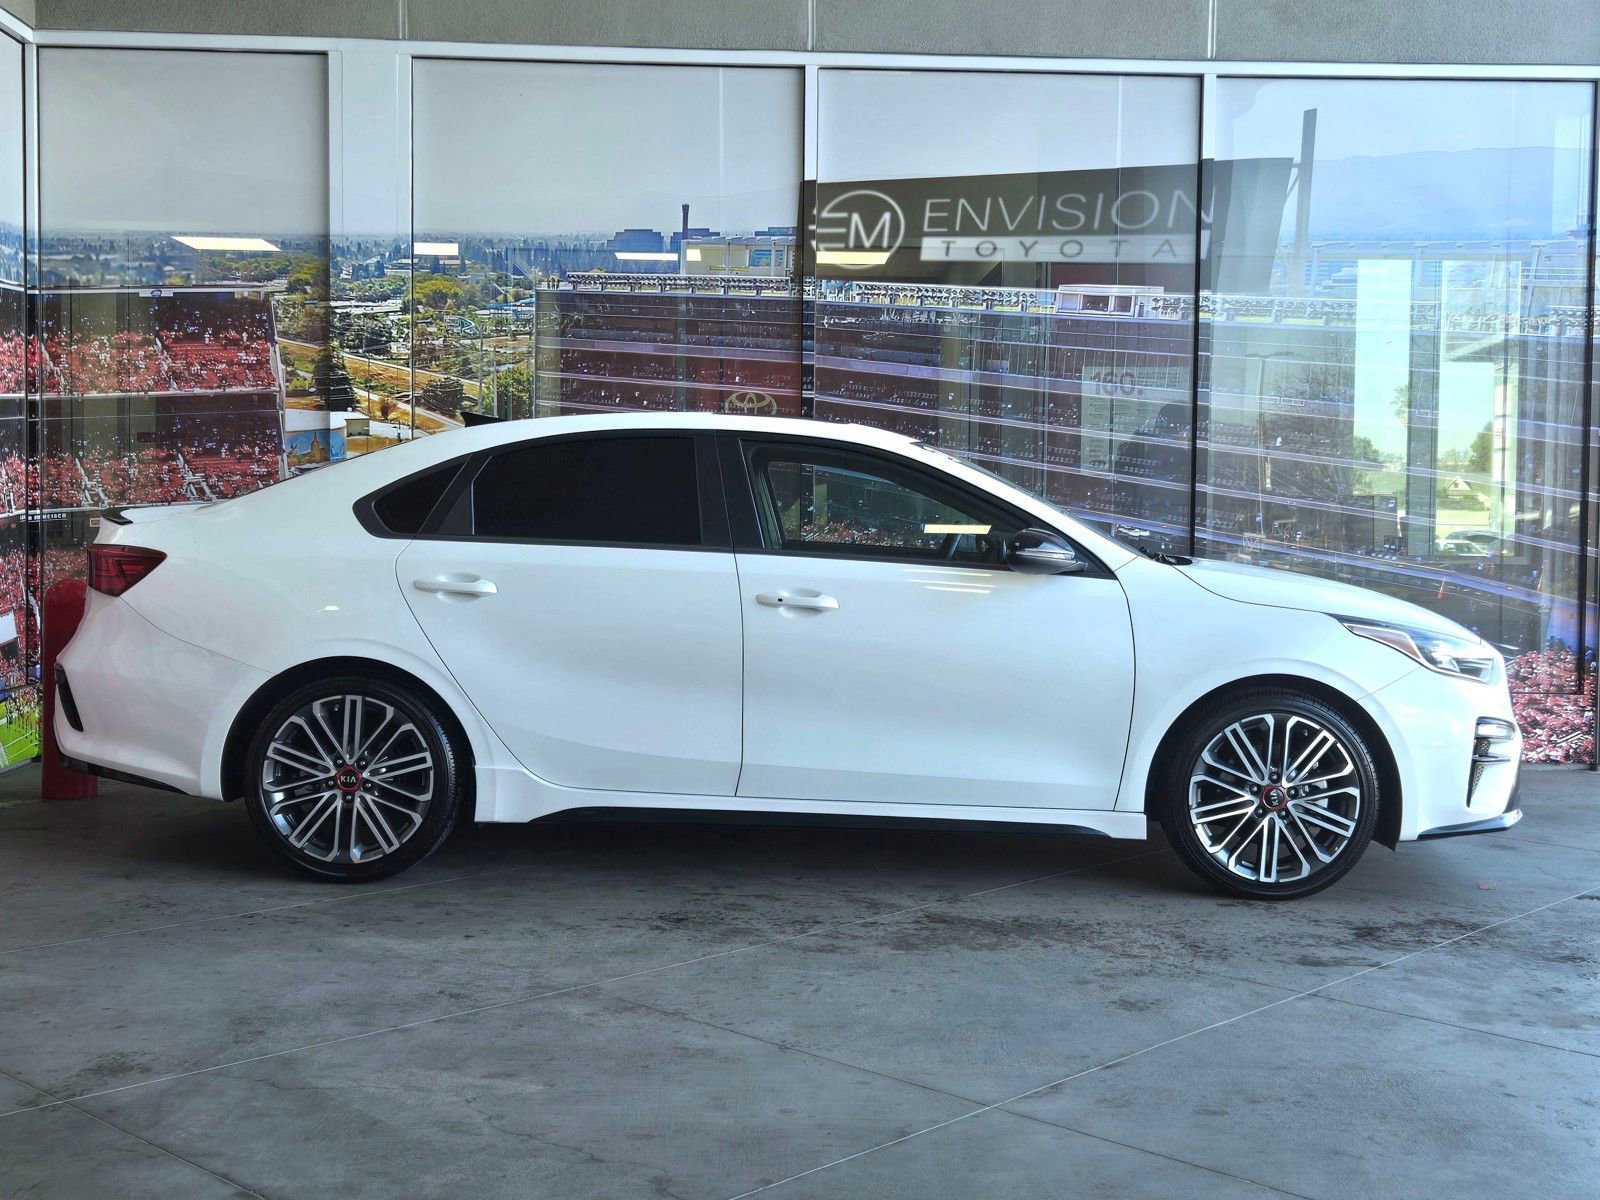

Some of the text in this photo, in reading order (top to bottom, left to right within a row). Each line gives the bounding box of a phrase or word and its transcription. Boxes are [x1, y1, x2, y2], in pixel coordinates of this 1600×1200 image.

[922, 185, 1215, 232] ENVISION
[941, 238, 1177, 259] TOYOTA
[340, 775, 357, 783] KIA
